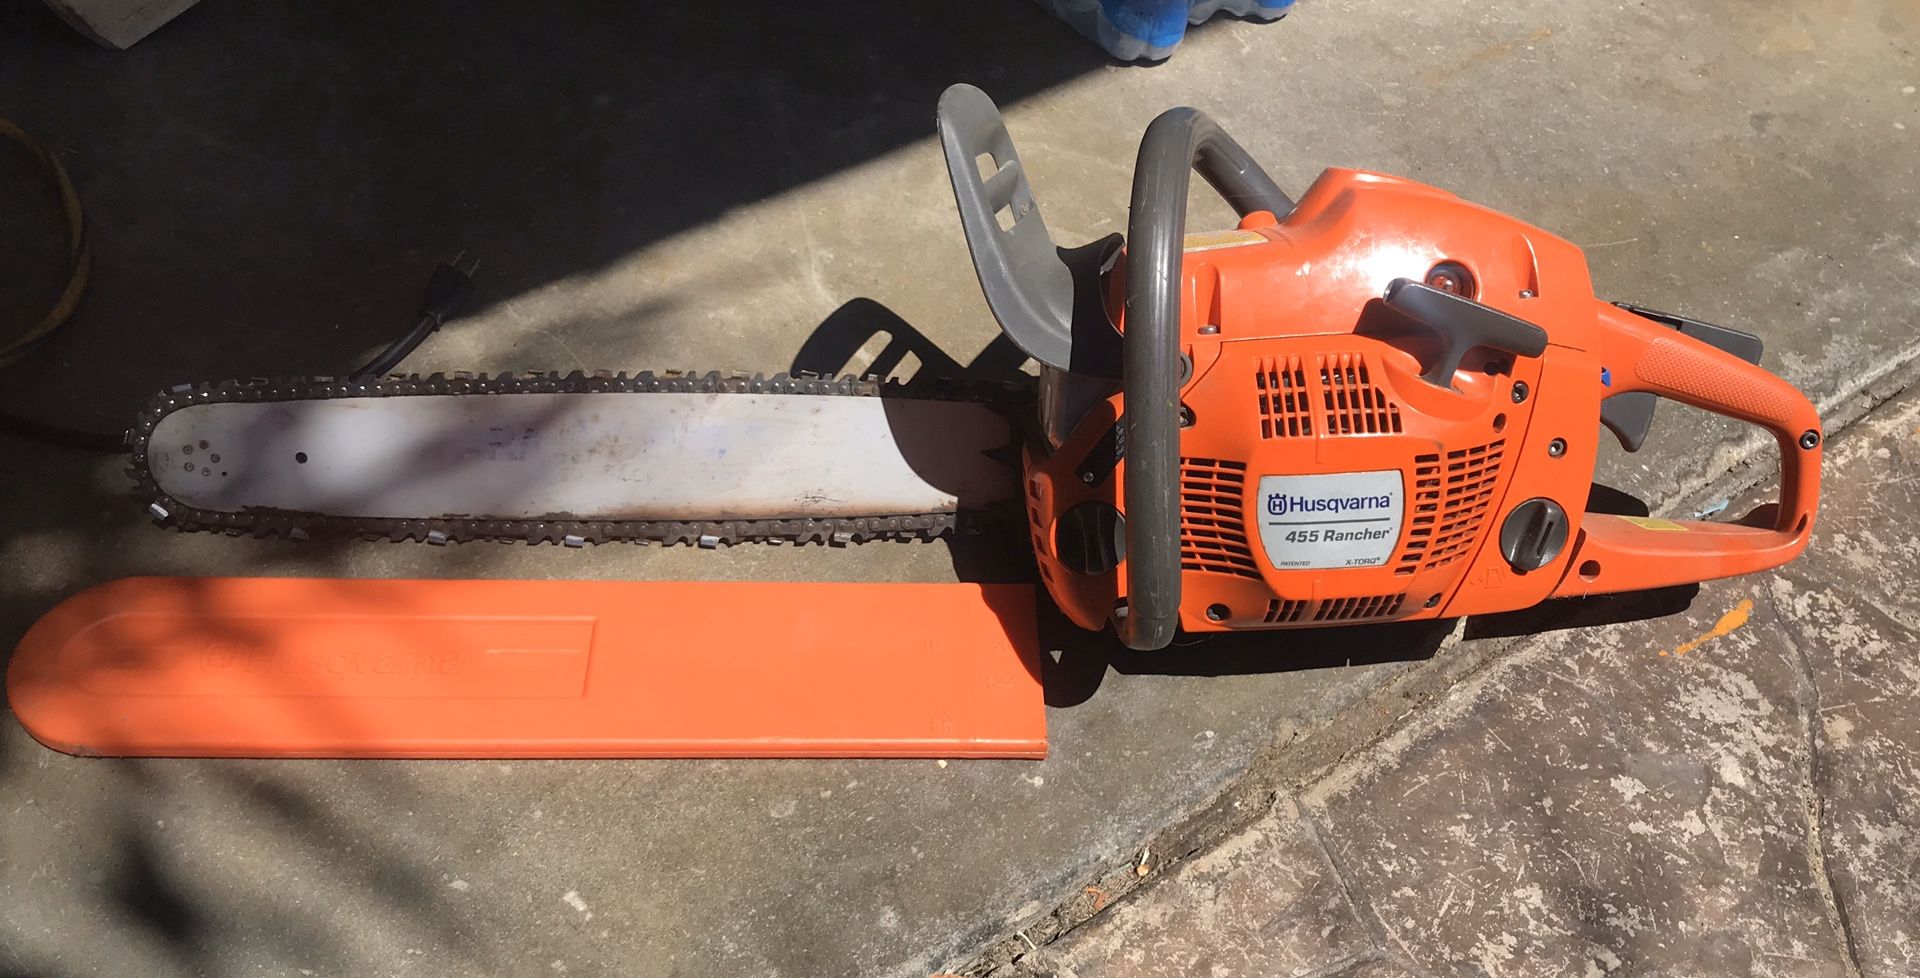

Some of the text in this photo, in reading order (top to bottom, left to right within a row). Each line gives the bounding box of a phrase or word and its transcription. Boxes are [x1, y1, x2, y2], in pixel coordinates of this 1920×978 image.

[1289, 495, 1390, 513] Husqvarna
[1285, 528, 1390, 543] 455 Rancher
